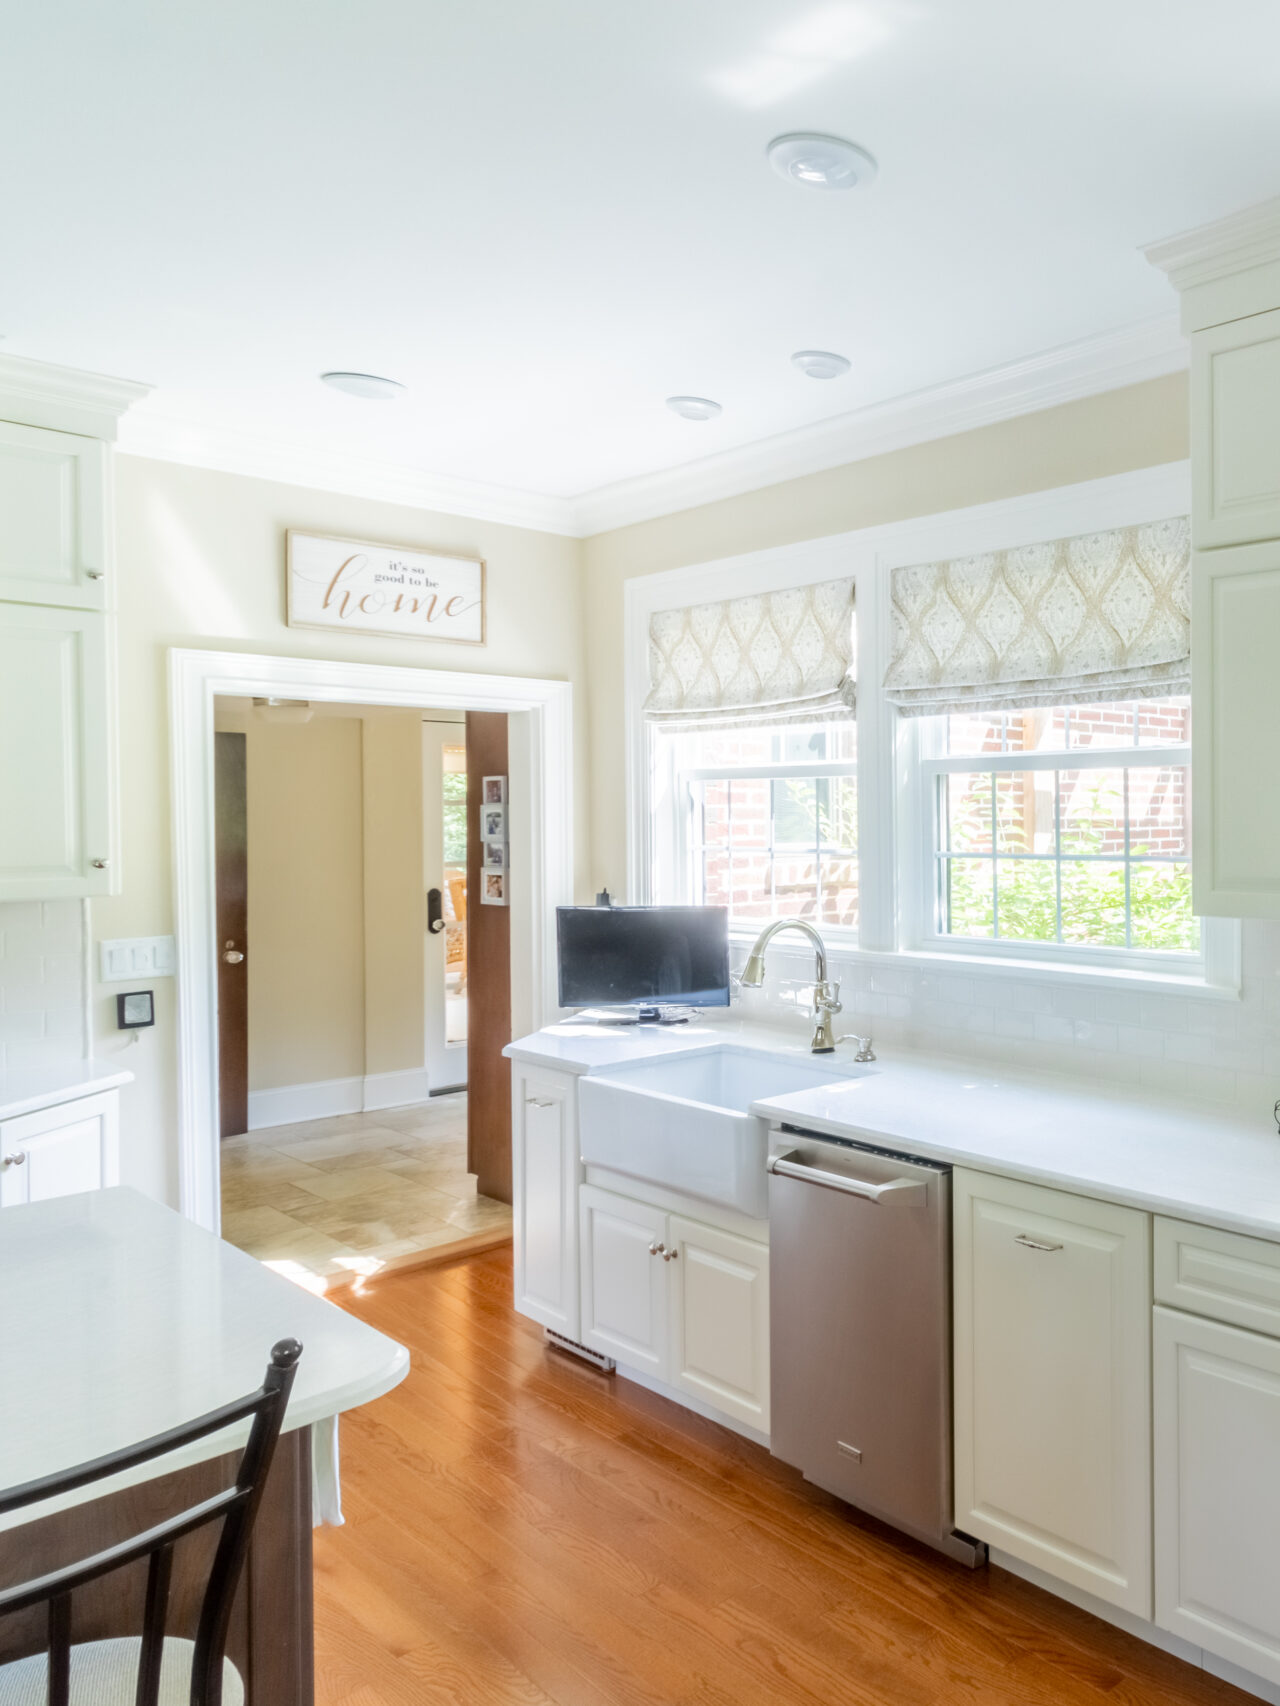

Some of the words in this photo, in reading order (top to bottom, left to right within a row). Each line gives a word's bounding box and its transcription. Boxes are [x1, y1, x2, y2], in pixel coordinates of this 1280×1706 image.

[389, 560, 408, 571] it's
[411, 567, 425, 575] so
[320, 553, 478, 623] home
[374, 574, 405, 584] good
[409, 577, 421, 586] to
[426, 577, 440, 588] be
